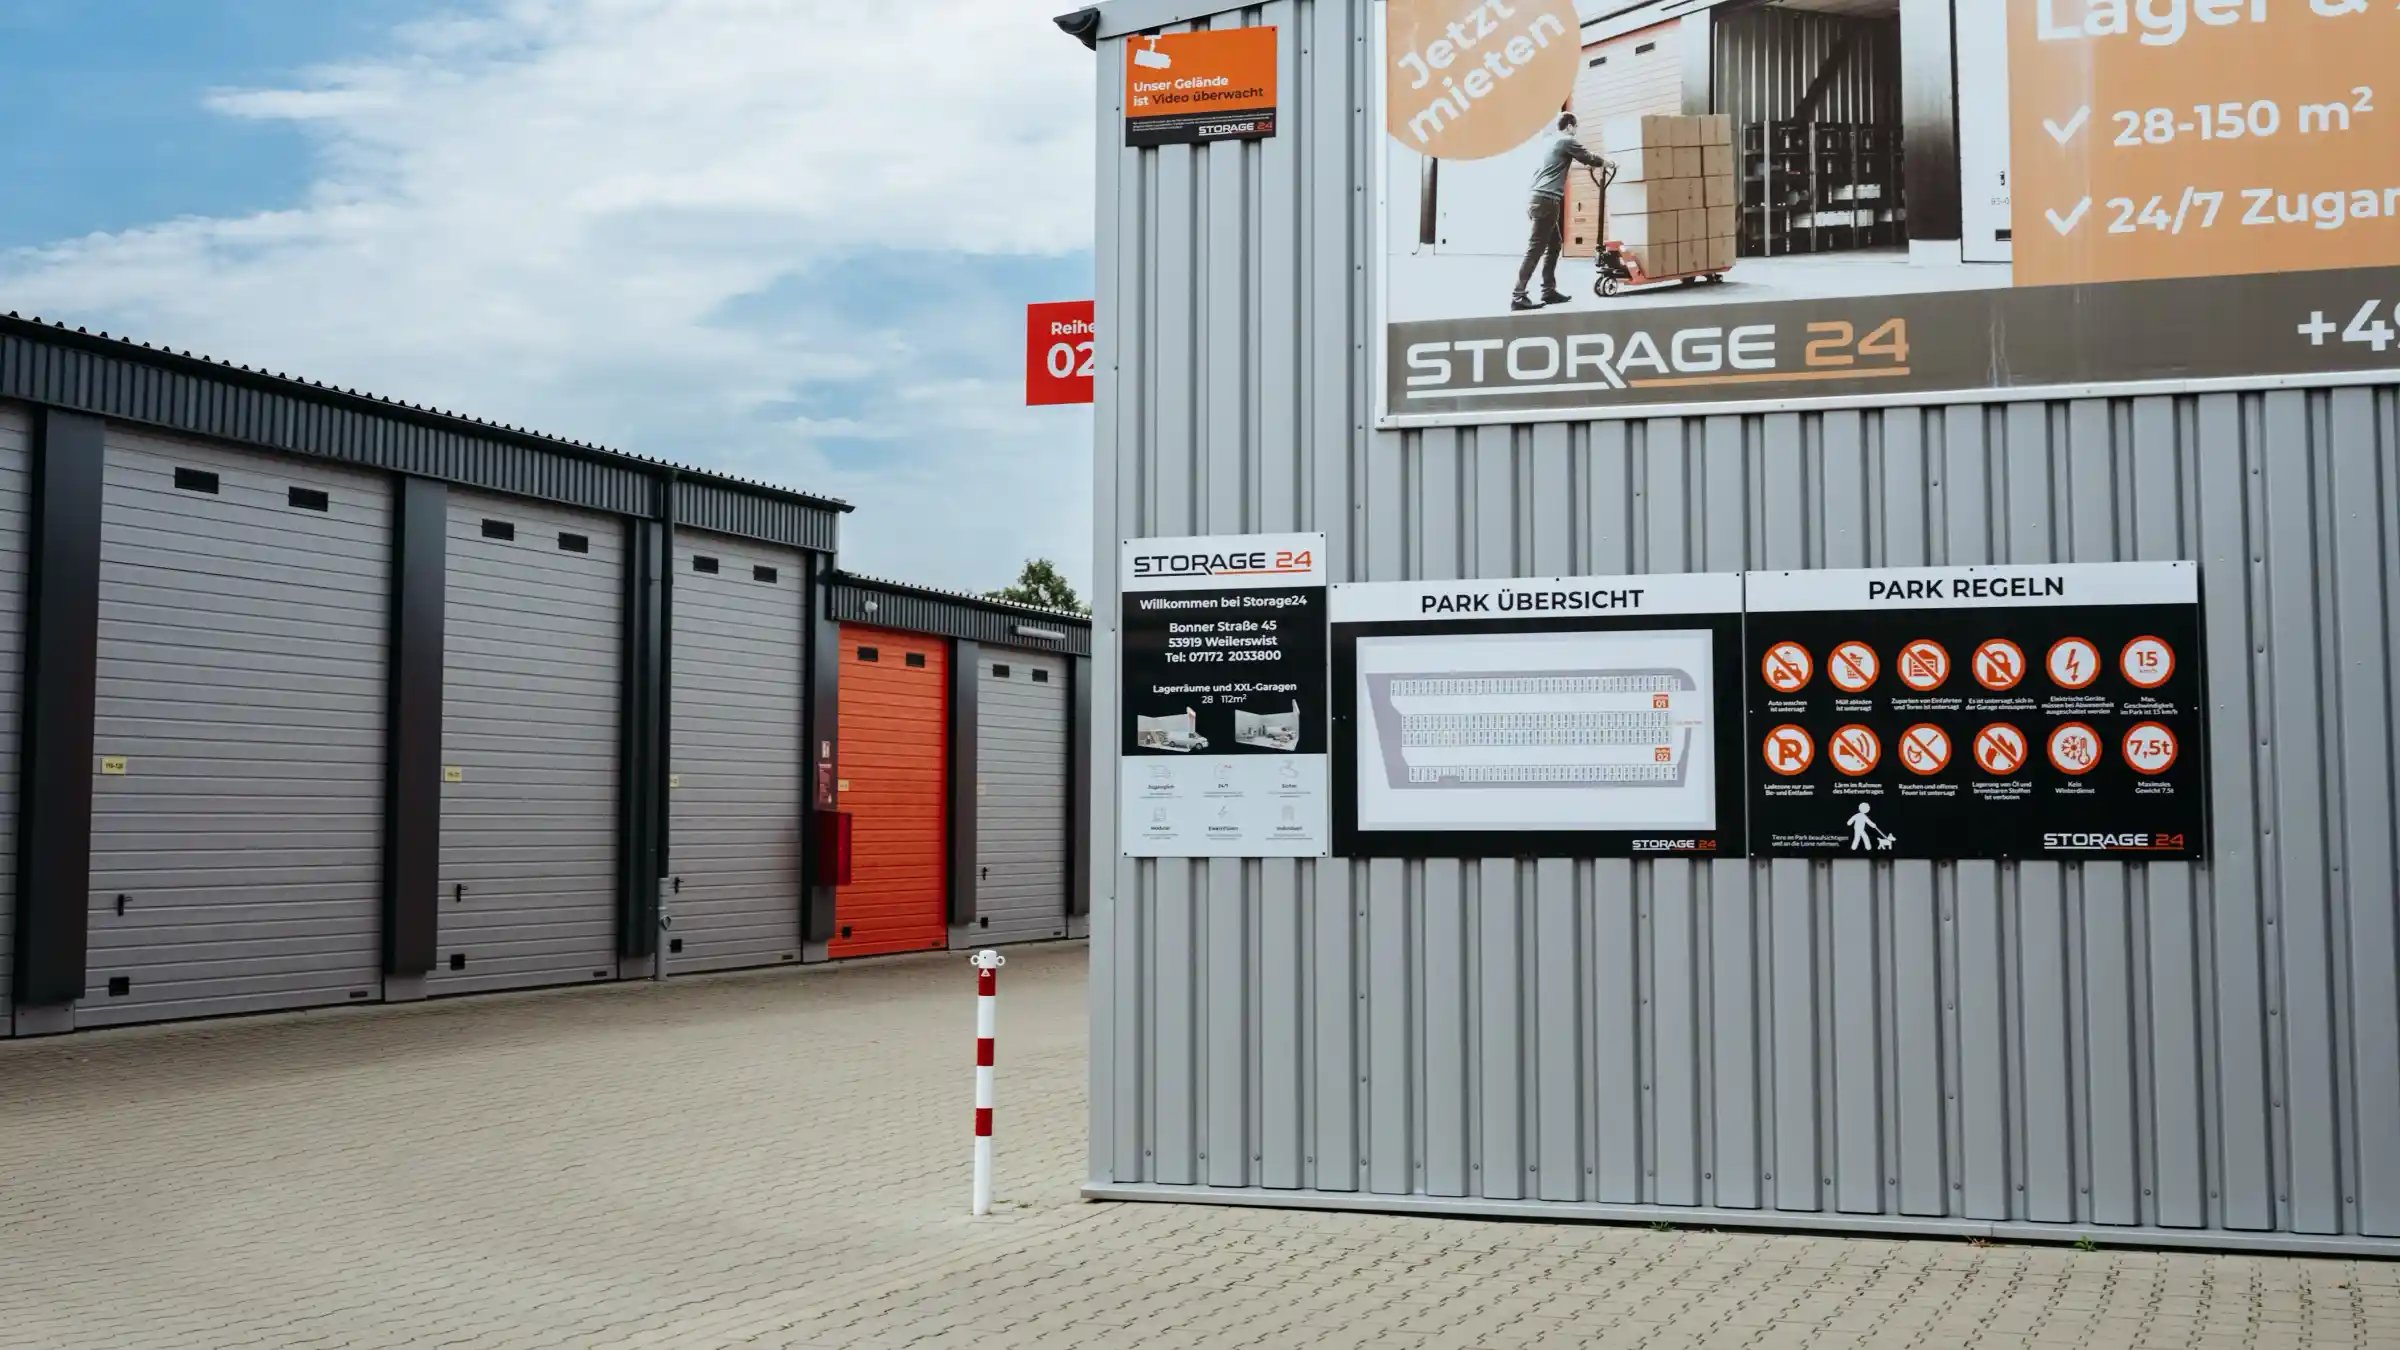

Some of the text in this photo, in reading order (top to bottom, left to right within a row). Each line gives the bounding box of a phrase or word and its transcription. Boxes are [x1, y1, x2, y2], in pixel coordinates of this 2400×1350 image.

[1397, 0, 1515, 89] Jetzt
[1133, 76, 1229, 92] Unser Gelände
[1408, 13, 1566, 144] mieten
[1133, 87, 1264, 107] ist Video überwacht
[1199, 122, 1255, 134] STORAGE
[1256, 121, 1273, 131] 24
[2112, 99, 2280, 147] 28-150
[2105, 186, 2224, 235] 24/7
[1051, 320, 1094, 335] Reihe
[2297, 299, 2400, 351] +4
[1047, 342, 1094, 378] 02
[1407, 318, 1909, 389] STORAGE 24
[1134, 551, 1312, 574] STORAGE 24
[1868, 577, 2064, 600] PARK REGELN
[1140, 595, 1308, 610] Willkommen bei Storage24
[1421, 588, 1644, 614] PARK ÜBERSICHT
[1169, 620, 1277, 634] Bonner Straße 45
[1168, 635, 1278, 648] 53919 Weilerswist
[1165, 650, 1281, 663] Tel: 07172 2033800
[2136, 651, 2158, 667] 15
[1153, 682, 1297, 694] Lagerräume und XXL-Garagen
[1201, 695, 1214, 704] 28
[1656, 700, 1666, 708] 01
[1657, 753, 1669, 761] 02
[2130, 740, 2171, 759] 7,5t
[1632, 839, 1716, 849] STORAGE 24
[2044, 832, 2184, 848] STORAGE 24
